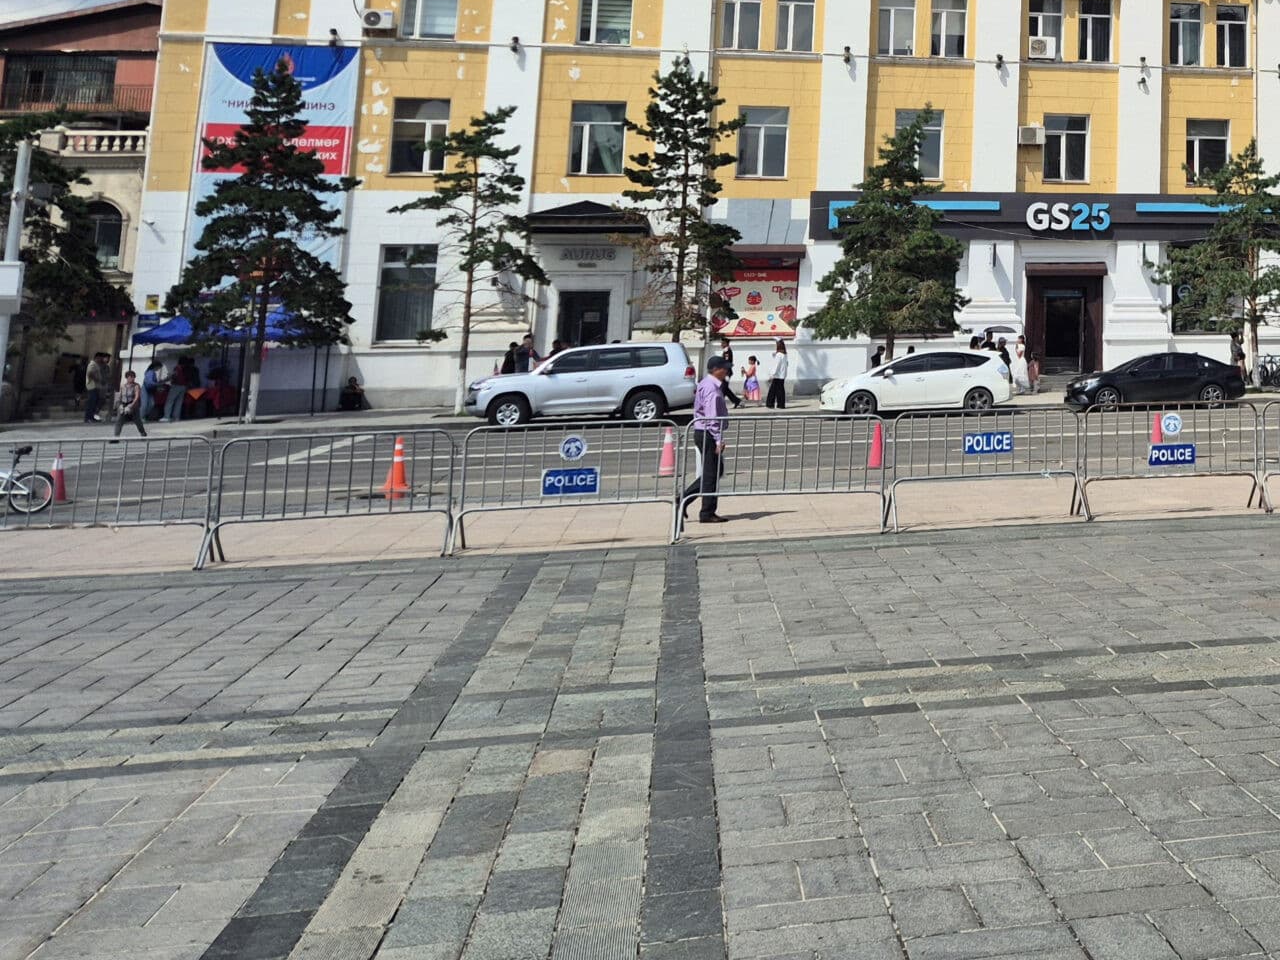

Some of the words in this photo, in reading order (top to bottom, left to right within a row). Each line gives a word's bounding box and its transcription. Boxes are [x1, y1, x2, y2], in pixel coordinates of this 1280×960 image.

[1026, 202, 1111, 231] GS25
[964, 433, 1011, 452] POLICE
[1152, 447, 1192, 462] POLICE
[545, 473, 596, 487] POLICE
